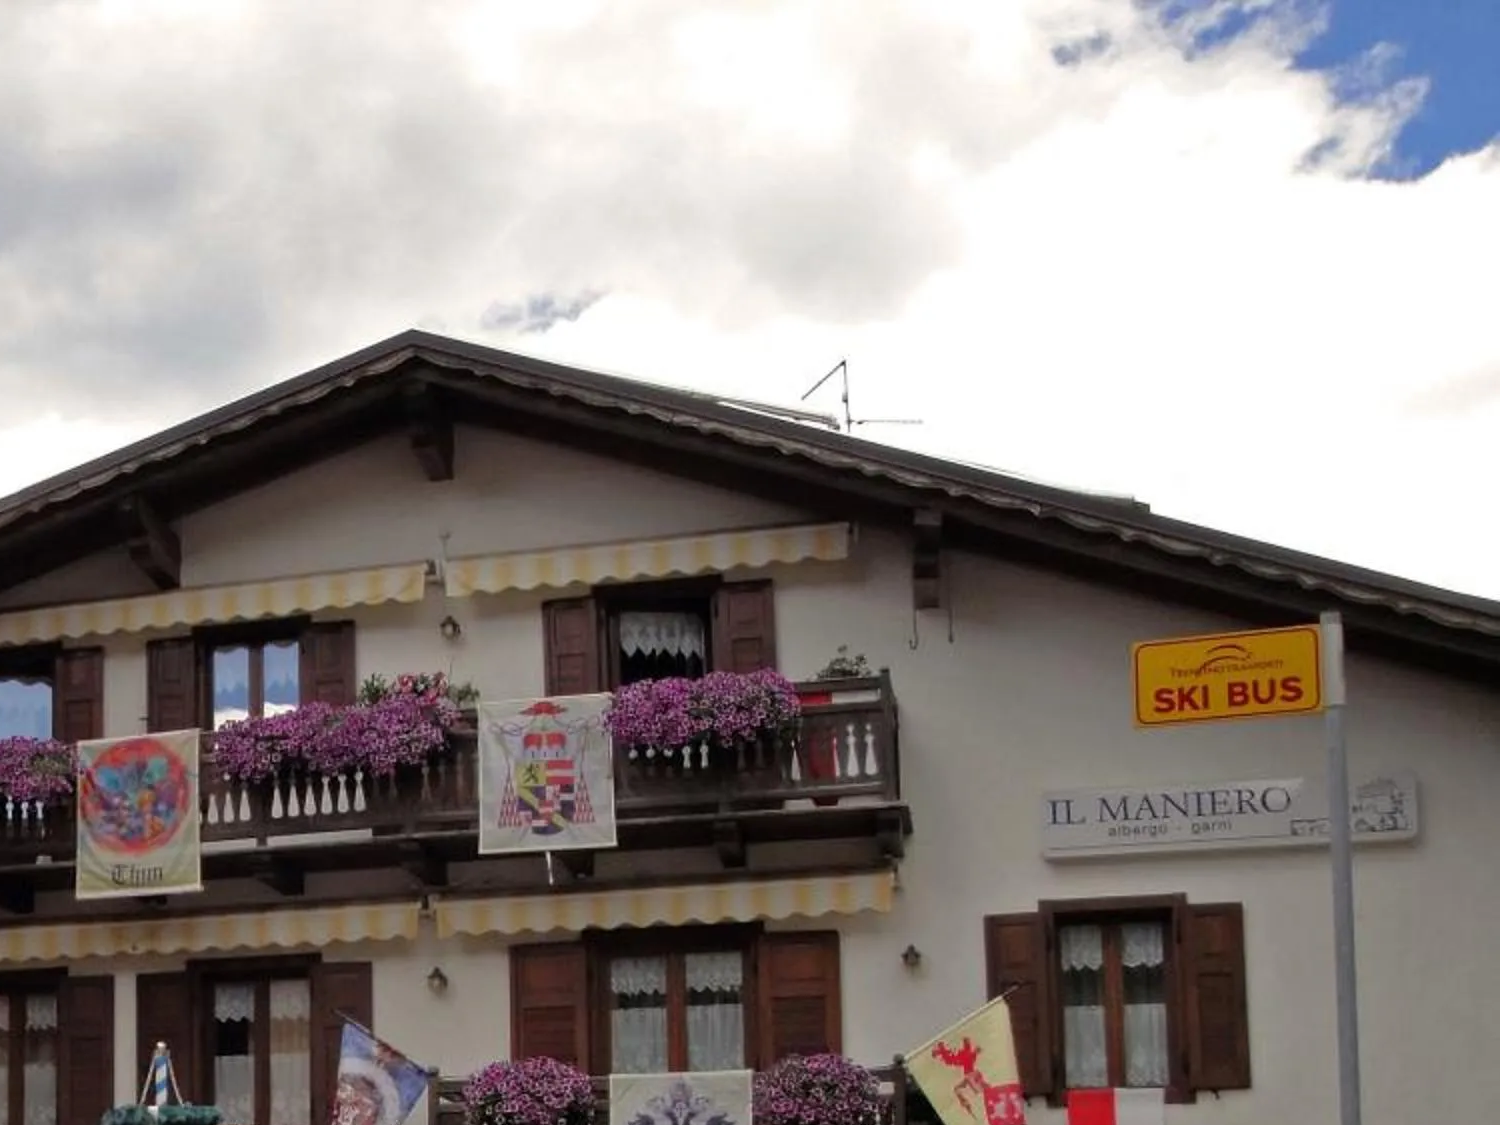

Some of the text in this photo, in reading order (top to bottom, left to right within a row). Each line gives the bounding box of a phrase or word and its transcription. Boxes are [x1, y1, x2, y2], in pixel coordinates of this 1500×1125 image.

[1153, 675, 1304, 714] SKI BUS
[1048, 786, 1291, 825] IL MANIERO
